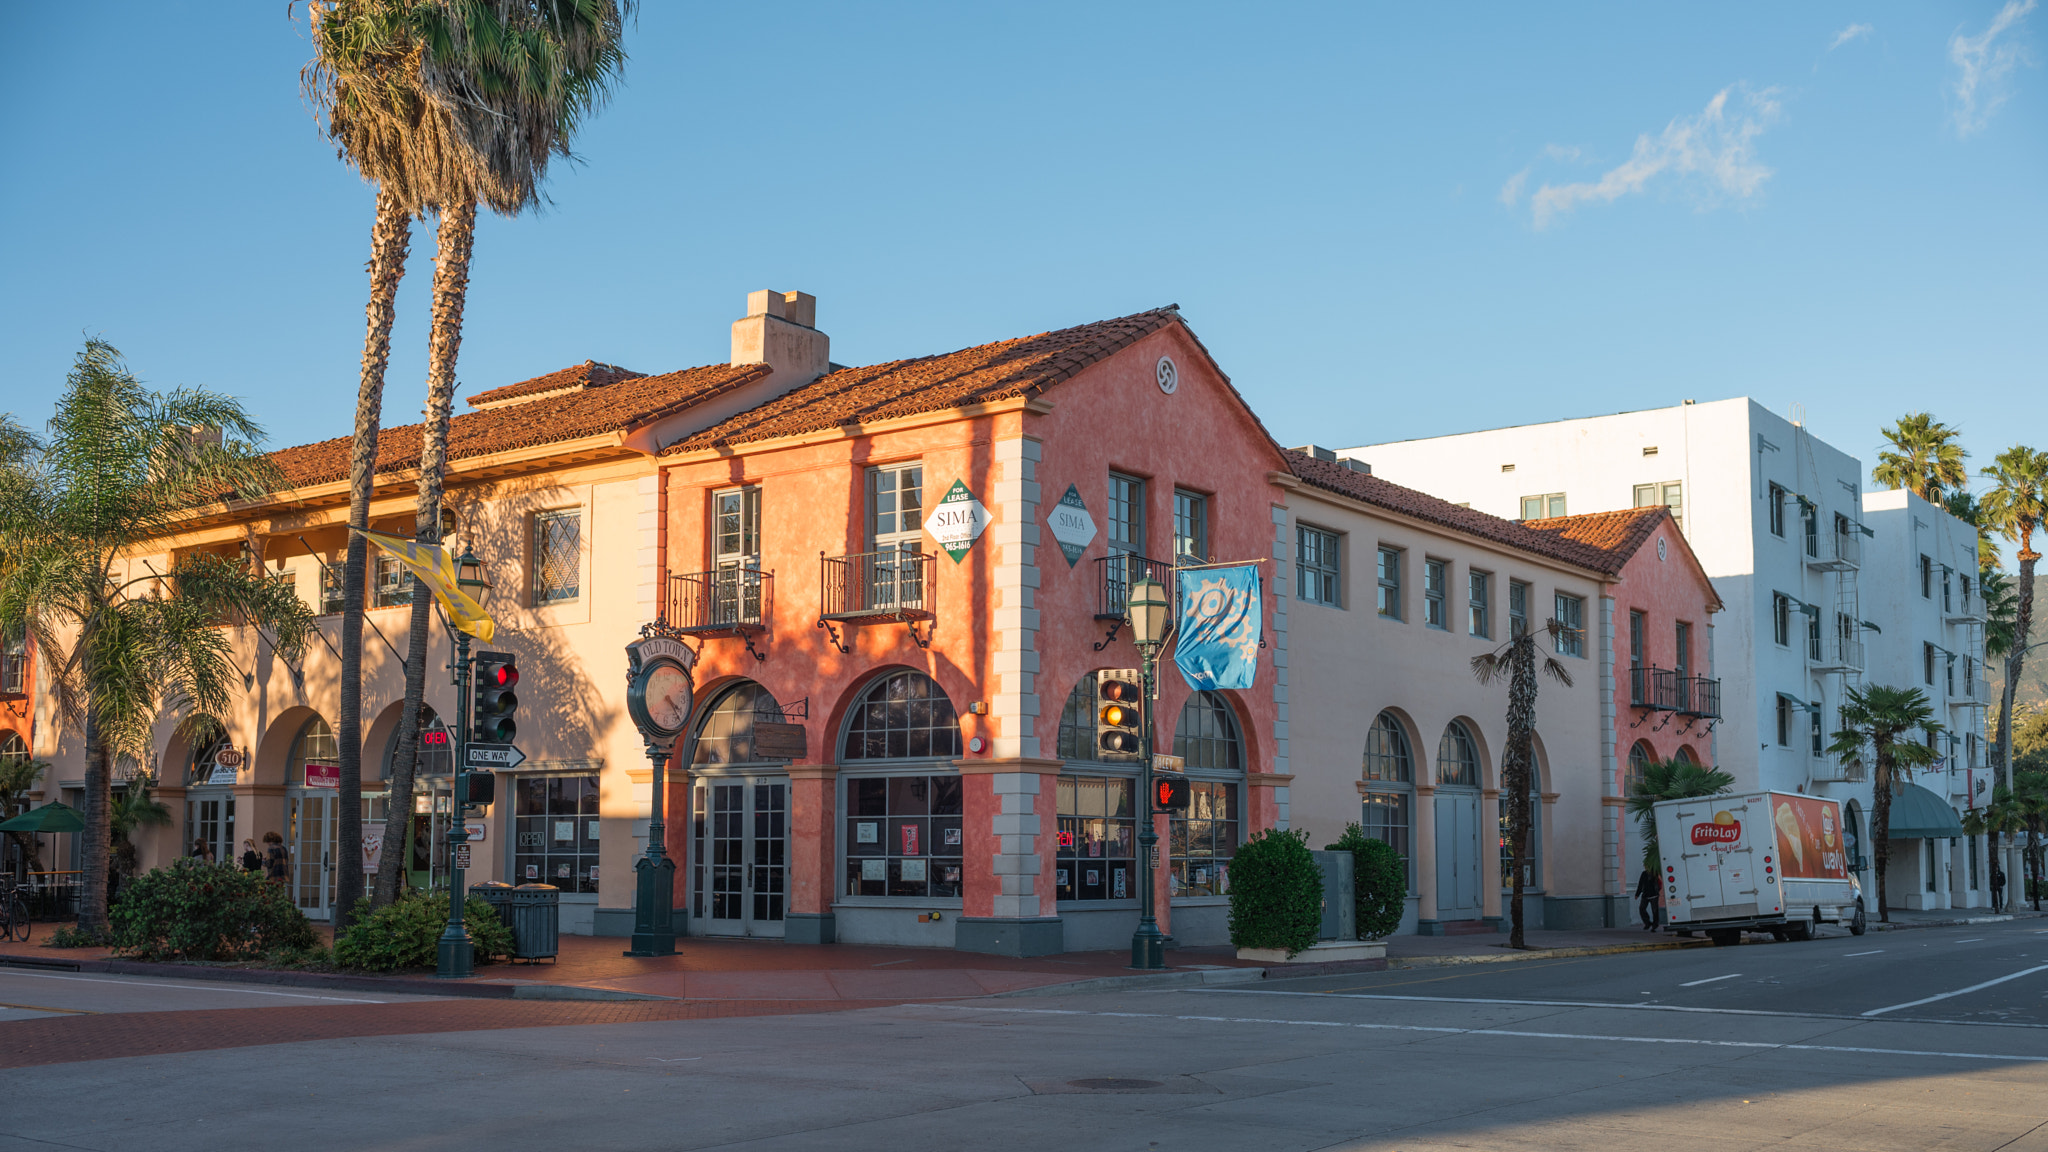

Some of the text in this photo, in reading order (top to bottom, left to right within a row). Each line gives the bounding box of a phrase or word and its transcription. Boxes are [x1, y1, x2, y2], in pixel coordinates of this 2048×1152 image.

[947, 493, 969, 502] LEASE
[1063, 496, 1082, 506] LEASE
[937, 509, 978, 527] SIMA
[1059, 512, 1085, 531] SIMA
[945, 541, 971, 551] 965-1616
[642, 640, 690, 662] OLD TOWN
[425, 732, 447, 744] OPEN
[220, 753, 239, 764] 510
[472, 750, 509, 761] ONE WAY
[520, 832, 544, 846] OPEN
[1056, 831, 1073, 846] PEN
[1711, 842, 1741, 853] Good fun!
